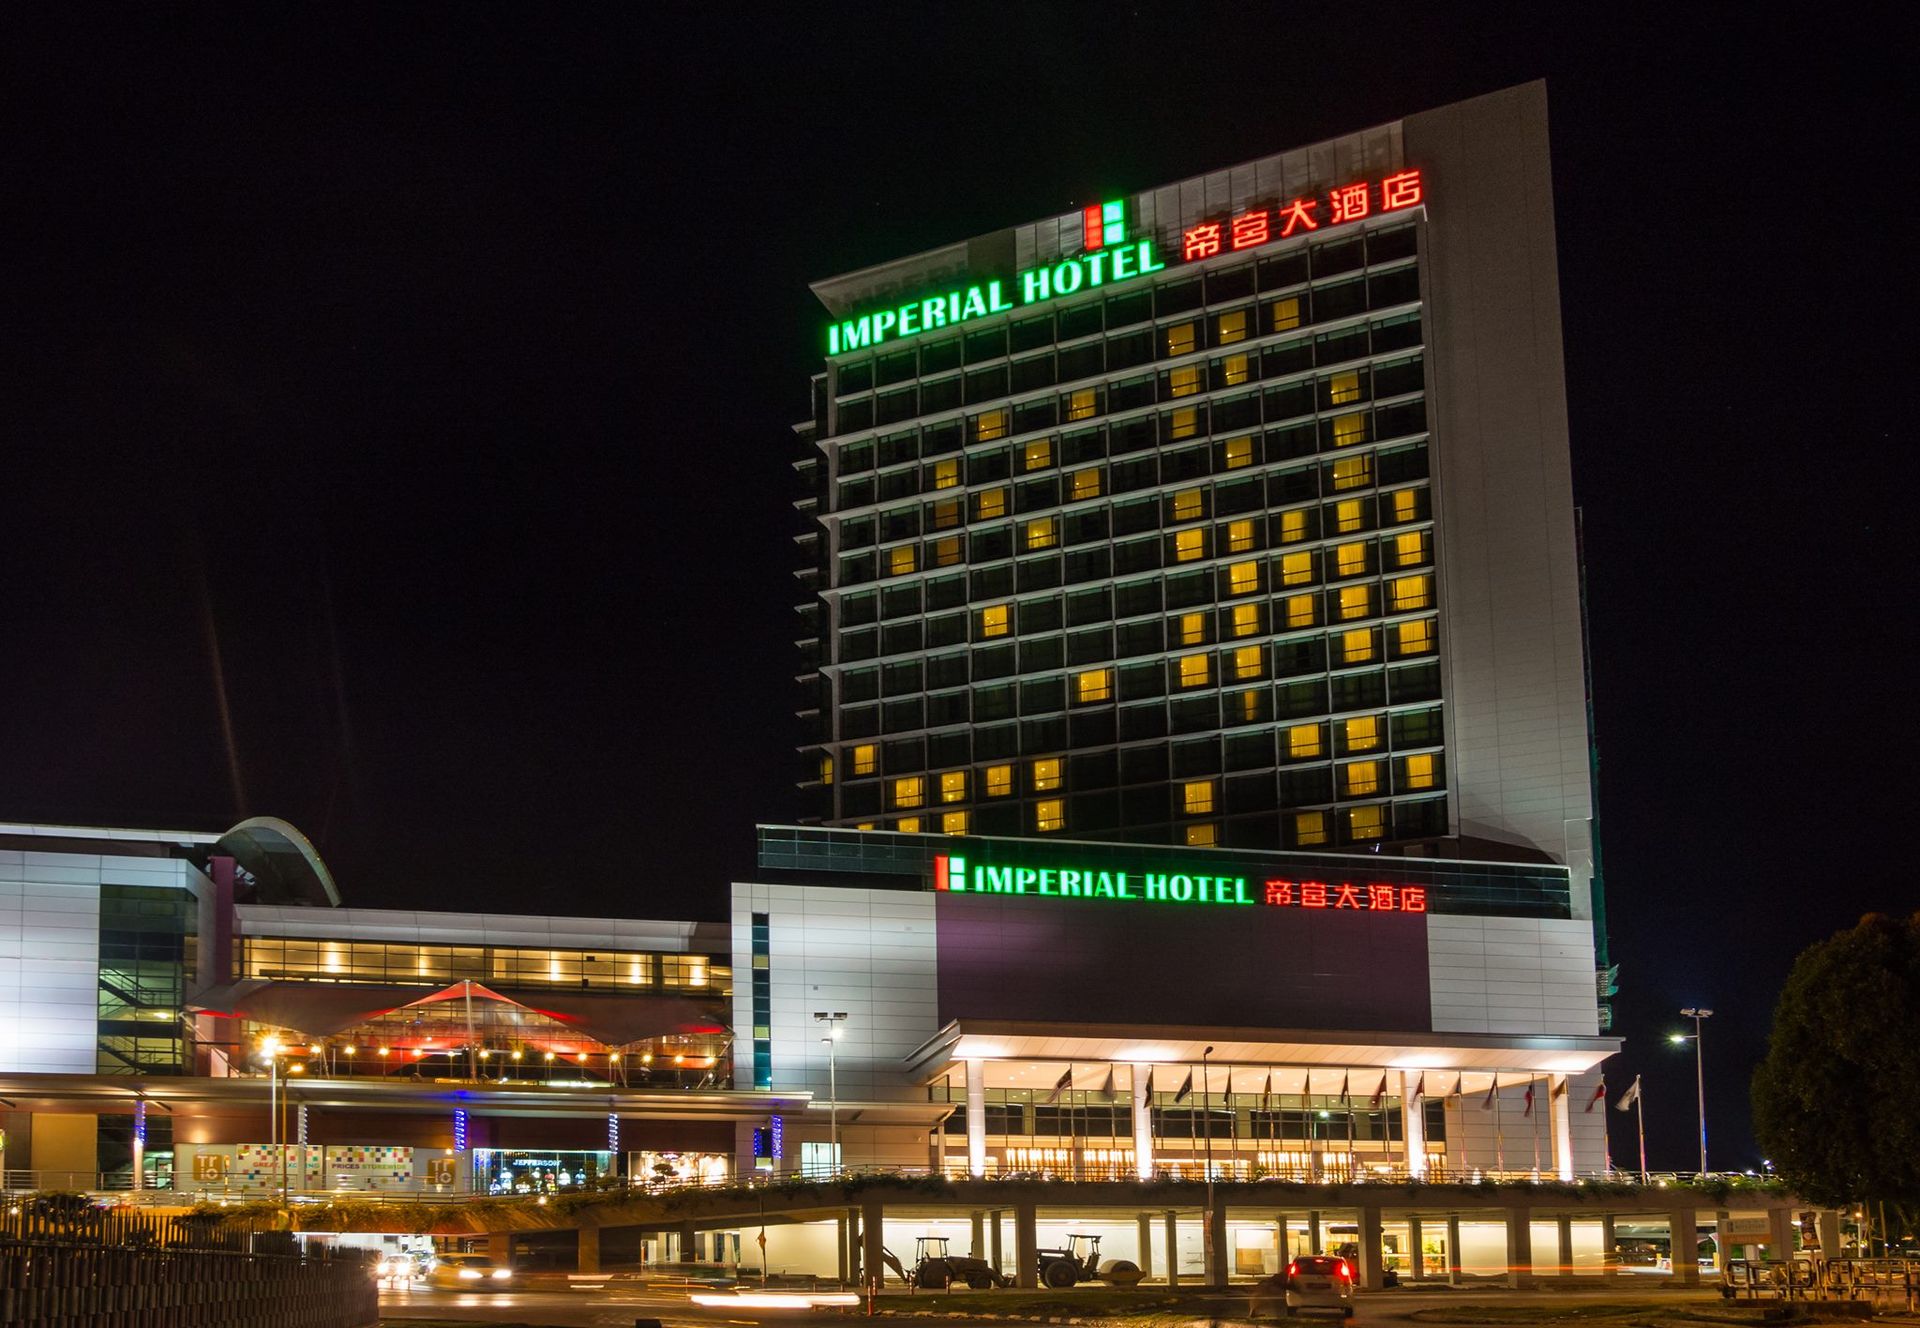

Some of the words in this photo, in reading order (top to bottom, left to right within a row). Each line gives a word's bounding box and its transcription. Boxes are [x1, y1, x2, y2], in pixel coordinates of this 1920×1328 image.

[828, 281, 1013, 355] IMPERIAL
[1023, 240, 1165, 303] HOTEL
[974, 865, 1136, 899] IMPERIAL
[1145, 873, 1255, 904] HOTEL
